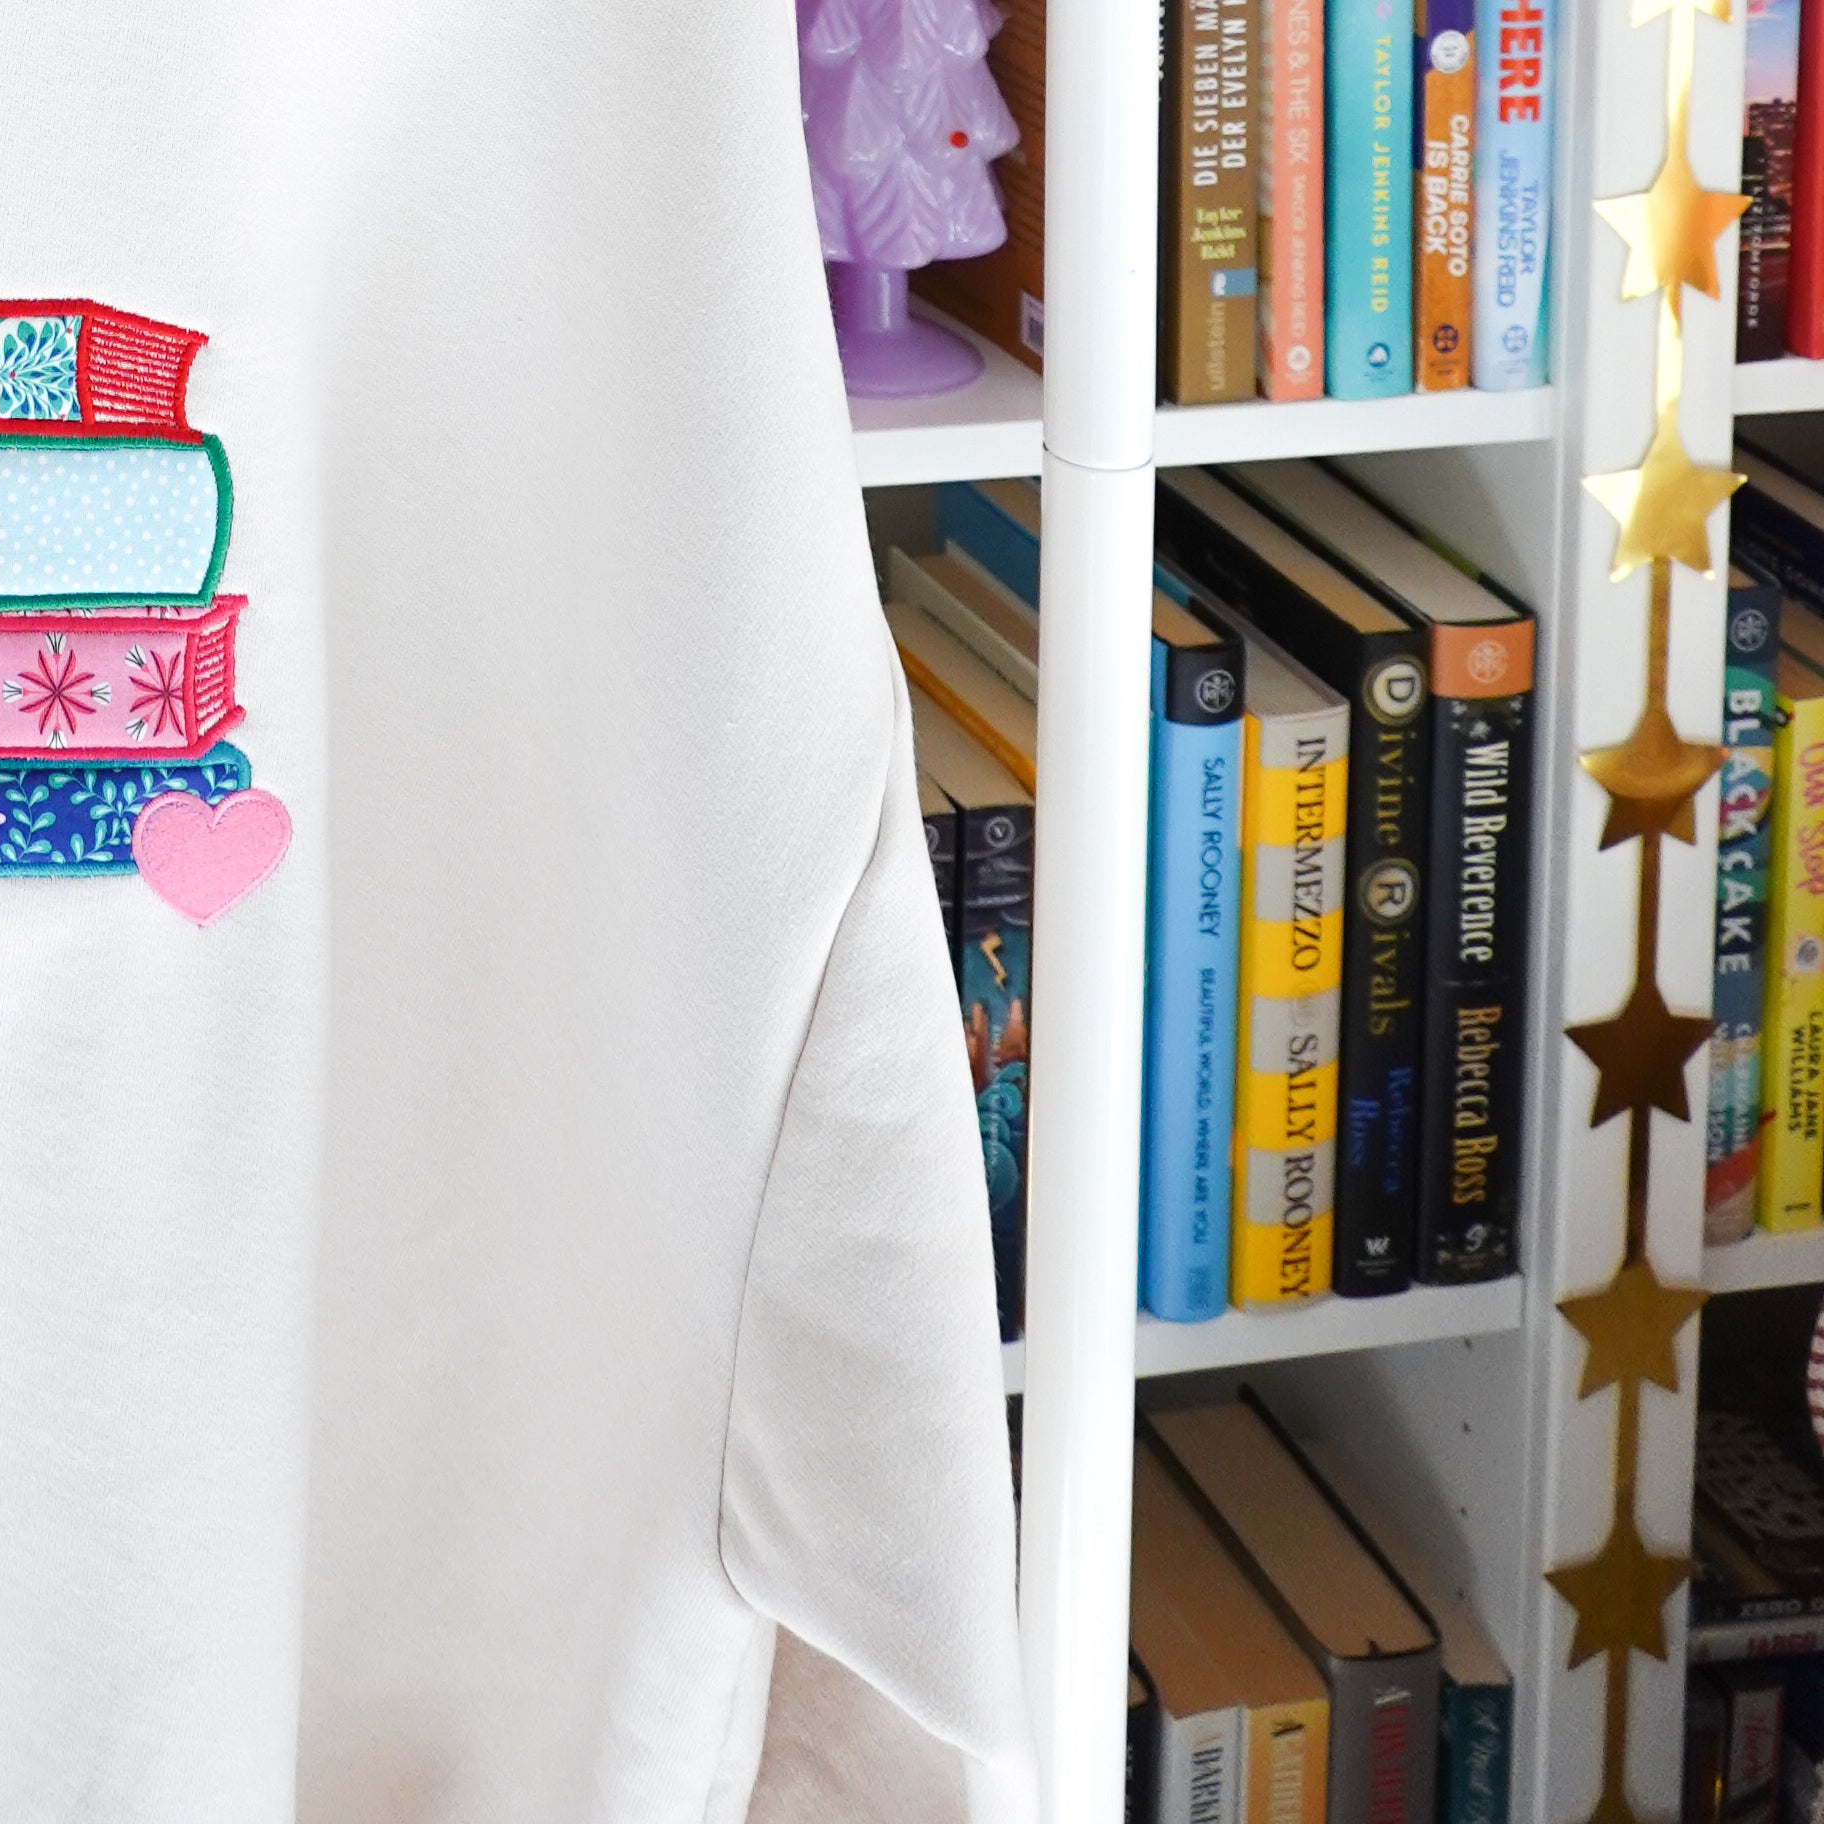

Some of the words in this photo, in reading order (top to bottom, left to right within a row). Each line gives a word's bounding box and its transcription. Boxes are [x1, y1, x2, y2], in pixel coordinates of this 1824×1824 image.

[1193, 43, 1219, 133] SIEBEN
[1221, 18, 1248, 109] EVELYN
[1193, 143, 1218, 186] DIE
[1220, 120, 1247, 169] DER
[1426, 141, 1443, 168] IS
[1446, 116, 1469, 199] CARRIE
[1424, 174, 1443, 256] BACK
[1446, 203, 1465, 277] SOTO
[1463, 740, 1510, 807] Wild
[1722, 687, 1762, 838] BLACK
[1291, 735, 1326, 972] INTERMEZZO
[1460, 813, 1508, 962] Reverence
[1719, 850, 1752, 975] CAKE
[1286, 1034, 1319, 1145] SALLY
[1455, 1005, 1503, 1129] Rebecca
[1452, 1134, 1499, 1206] Ross
[1279, 1150, 1315, 1301] ROONEY
